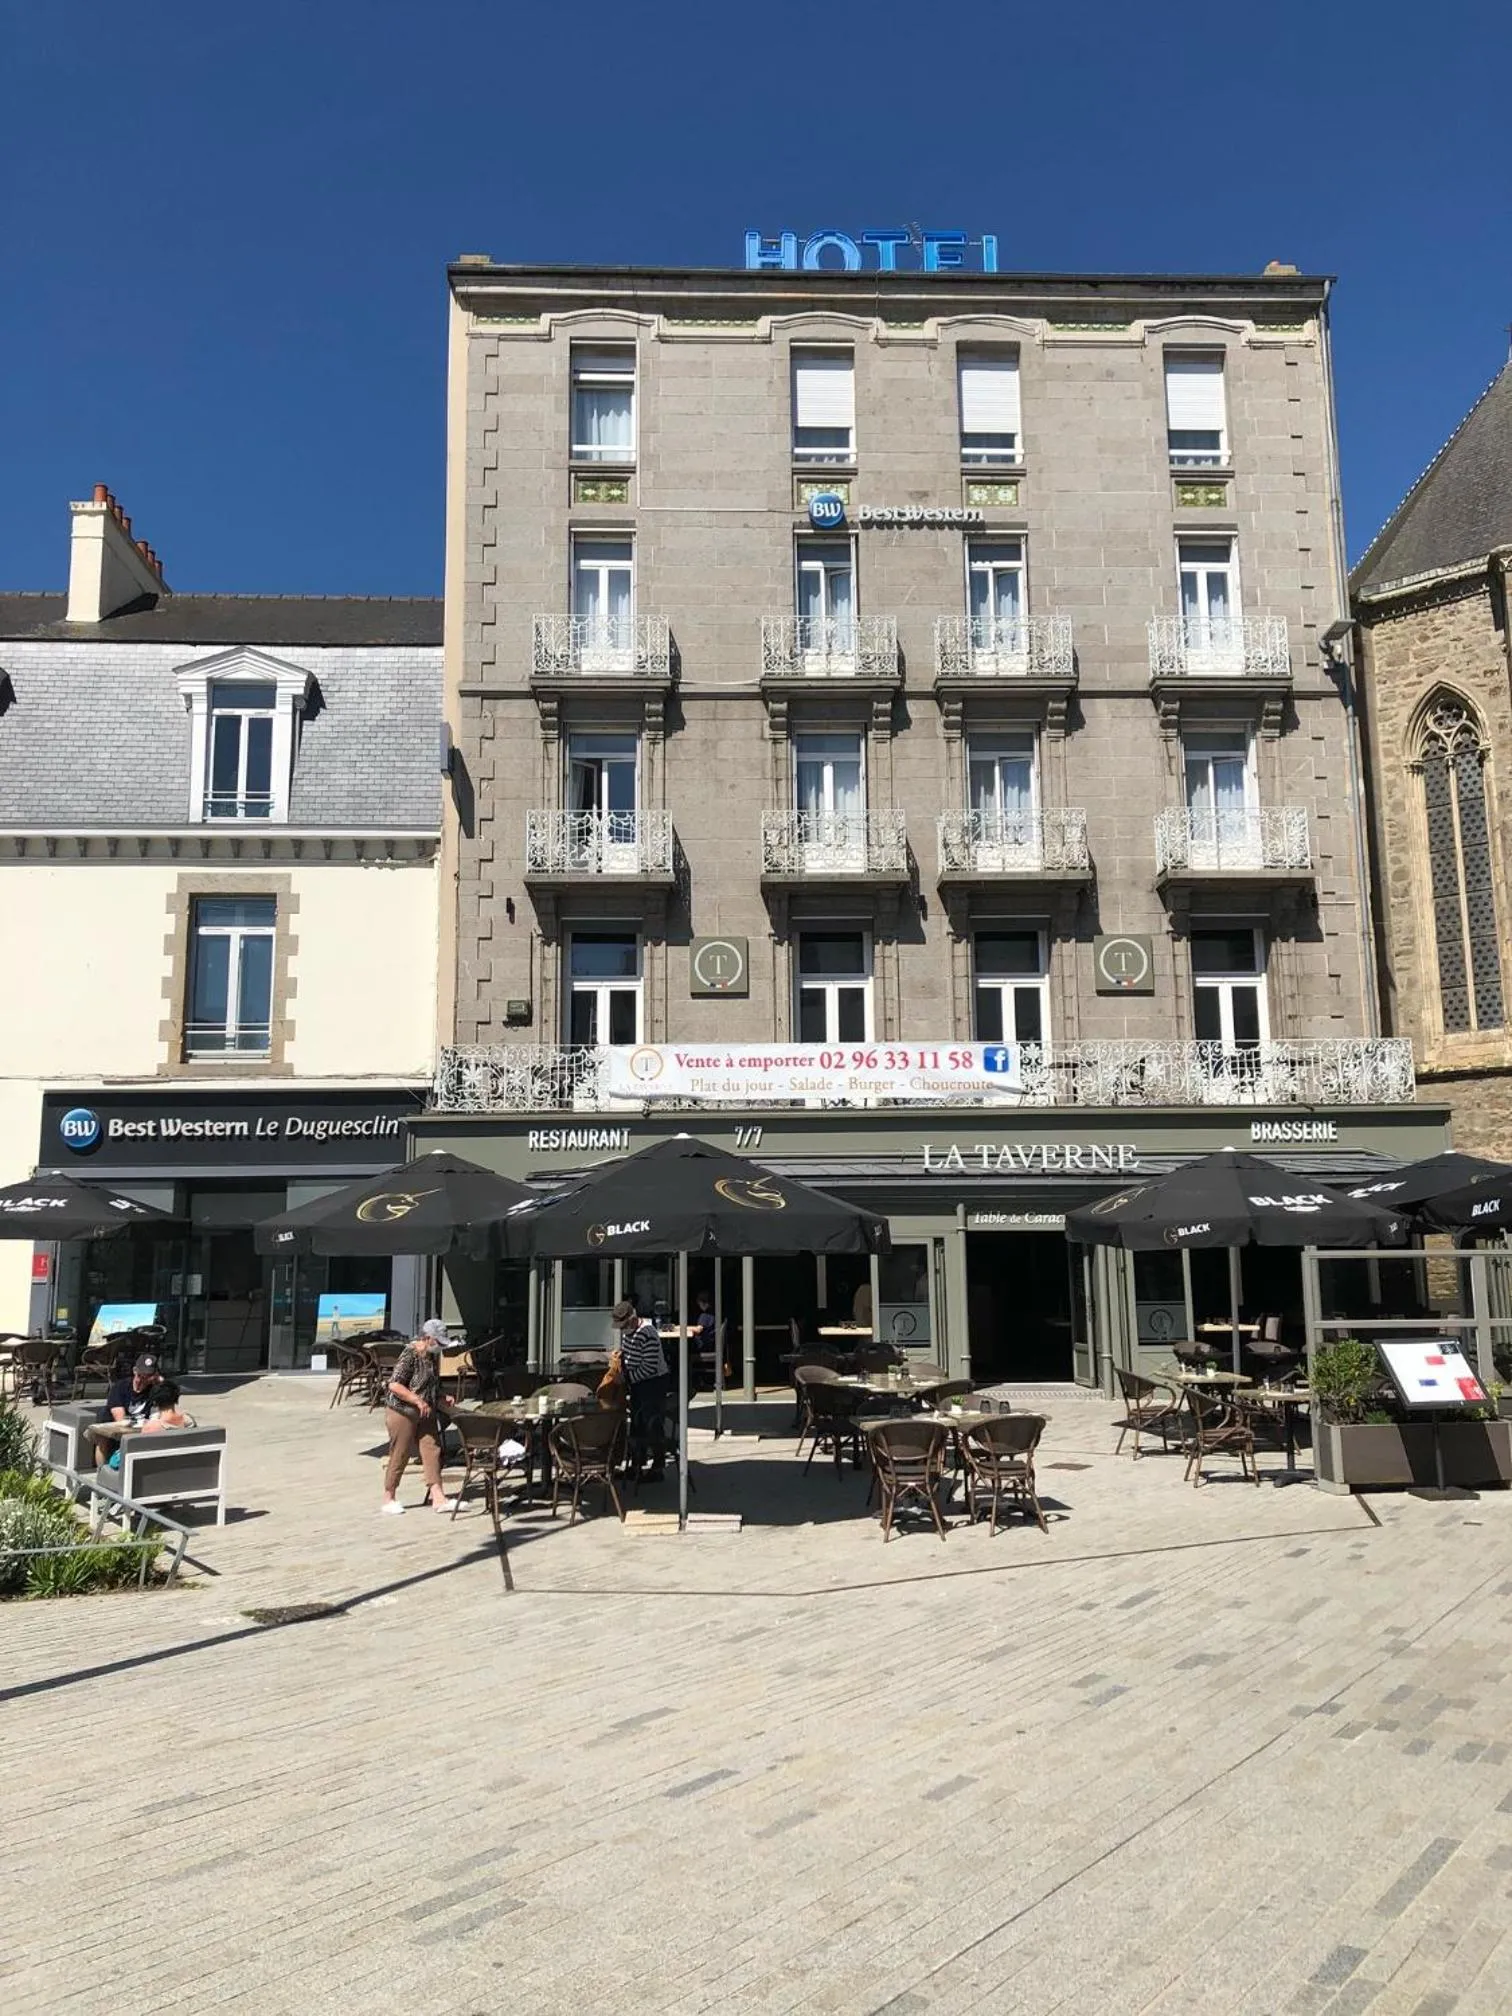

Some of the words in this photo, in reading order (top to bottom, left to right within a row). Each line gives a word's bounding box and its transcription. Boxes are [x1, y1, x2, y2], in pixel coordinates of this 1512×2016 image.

[812, 503, 841, 518] BW
[858, 505, 902, 521] Best
[709, 954, 728, 975] T
[1113, 951, 1133, 972] T
[674, 1053, 721, 1069] Vente
[725, 1052, 735, 1069] à
[738, 1055, 815, 1073] emporter
[819, 1050, 846, 1070] 02
[851, 1048, 879, 1071] 96
[884, 1050, 910, 1071] 33
[918, 1050, 941, 1070] 11
[949, 1050, 974, 1070] 58
[691, 1078, 719, 1092] Plat
[722, 1078, 740, 1092] du
[744, 1079, 774, 1095] jour
[790, 1077, 833, 1091] Salade
[849, 1077, 895, 1094] Burger
[910, 1076, 994, 1092] Choucroute
[63, 1121, 96, 1137] BW
[108, 1118, 156, 1137] Best
[159, 1118, 249, 1137] Western
[255, 1117, 278, 1137] Le
[284, 1115, 400, 1140] Duguesclin
[735, 1126, 762, 1147] 7/7
[1250, 1121, 1338, 1142] BRASSERIE
[528, 1128, 630, 1149] RESTAURANT
[922, 1144, 966, 1169] LA
[975, 1144, 1140, 1169] TAVERNE
[1248, 1194, 1334, 1206] BLACK
[1471, 1198, 1501, 1218] BLACK
[607, 1219, 650, 1236] BLACK
[1177, 1222, 1211, 1237] BLACK
